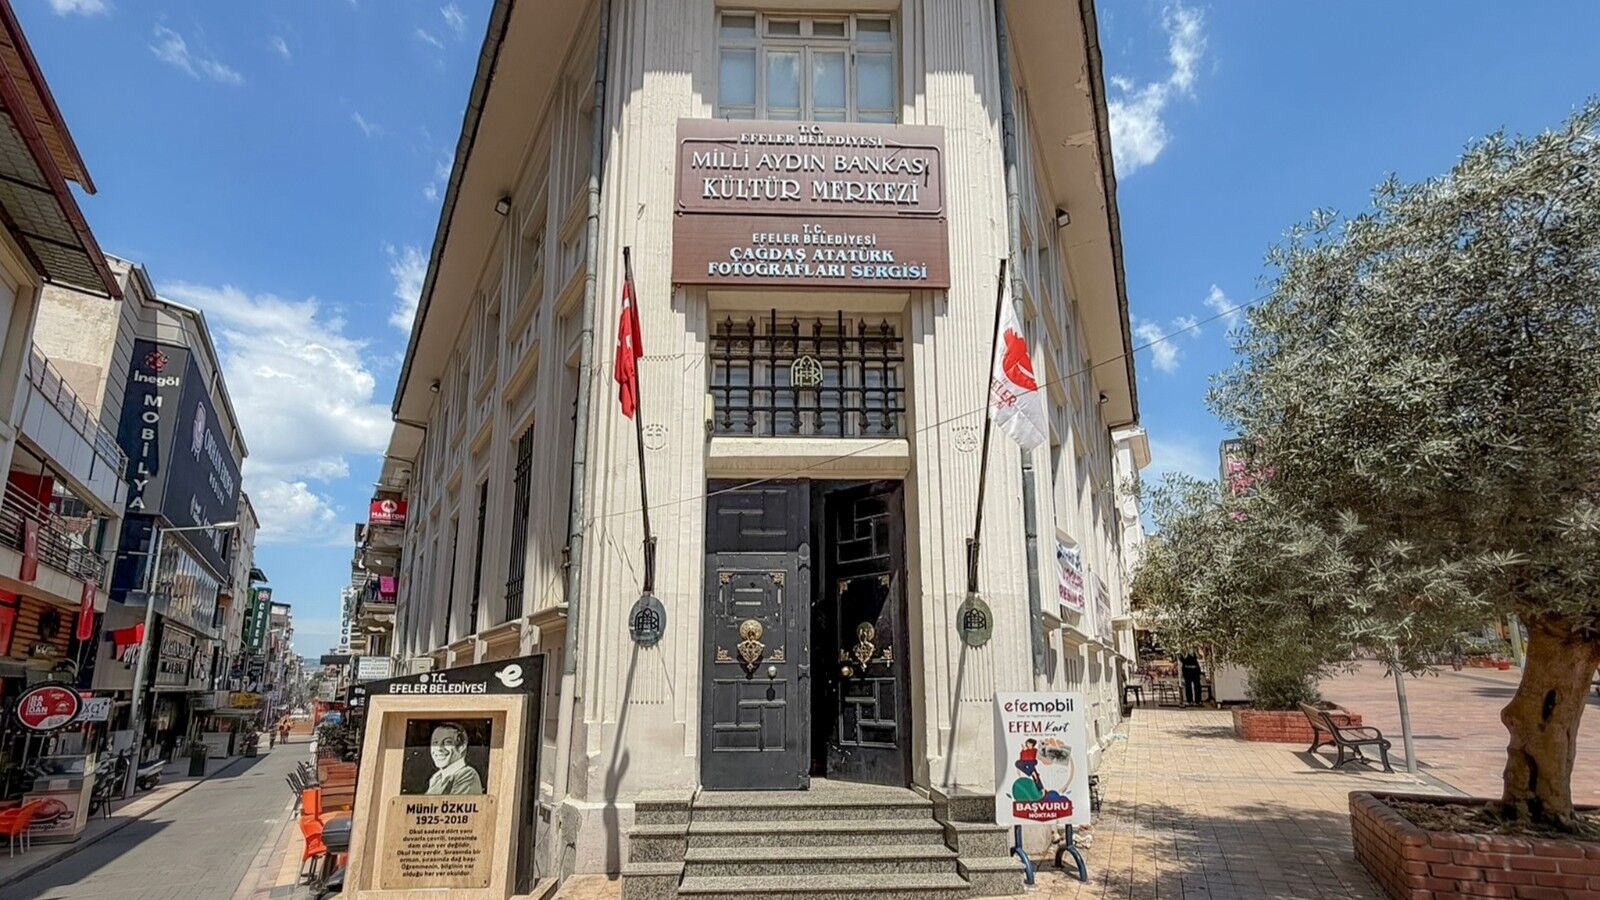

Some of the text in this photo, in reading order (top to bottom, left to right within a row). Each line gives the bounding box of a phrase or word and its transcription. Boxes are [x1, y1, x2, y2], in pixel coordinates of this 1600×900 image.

[798, 124, 824, 135] T.C.
[740, 134, 882, 148] EFELER BELEDİYESİ
[691, 149, 748, 169] MİLLİ
[755, 154, 825, 172] AYDIN
[702, 175, 919, 204] KÜLTÜR MERKEZİ
[803, 223, 826, 235] T.C.
[752, 233, 876, 246] EFELER BELEDİYESİ
[730, 245, 895, 263] ÇAĞDAŞ ATATÜRK
[708, 260, 927, 280] FOTOĞRAFLARI SERGİSİ
[134, 370, 180, 387] İnegöl
[129, 394, 162, 509] MOBİLYA
[389, 681, 487, 694] EFELER BELEDİYESİ
[1004, 698, 1074, 713] efemobil
[1008, 720, 1071, 733] EFEM Kart
[406, 800, 479, 814] Münir ÖZKUL
[1016, 802, 1069, 813] BAŞVURU
[416, 815, 469, 825] 1925-2018
